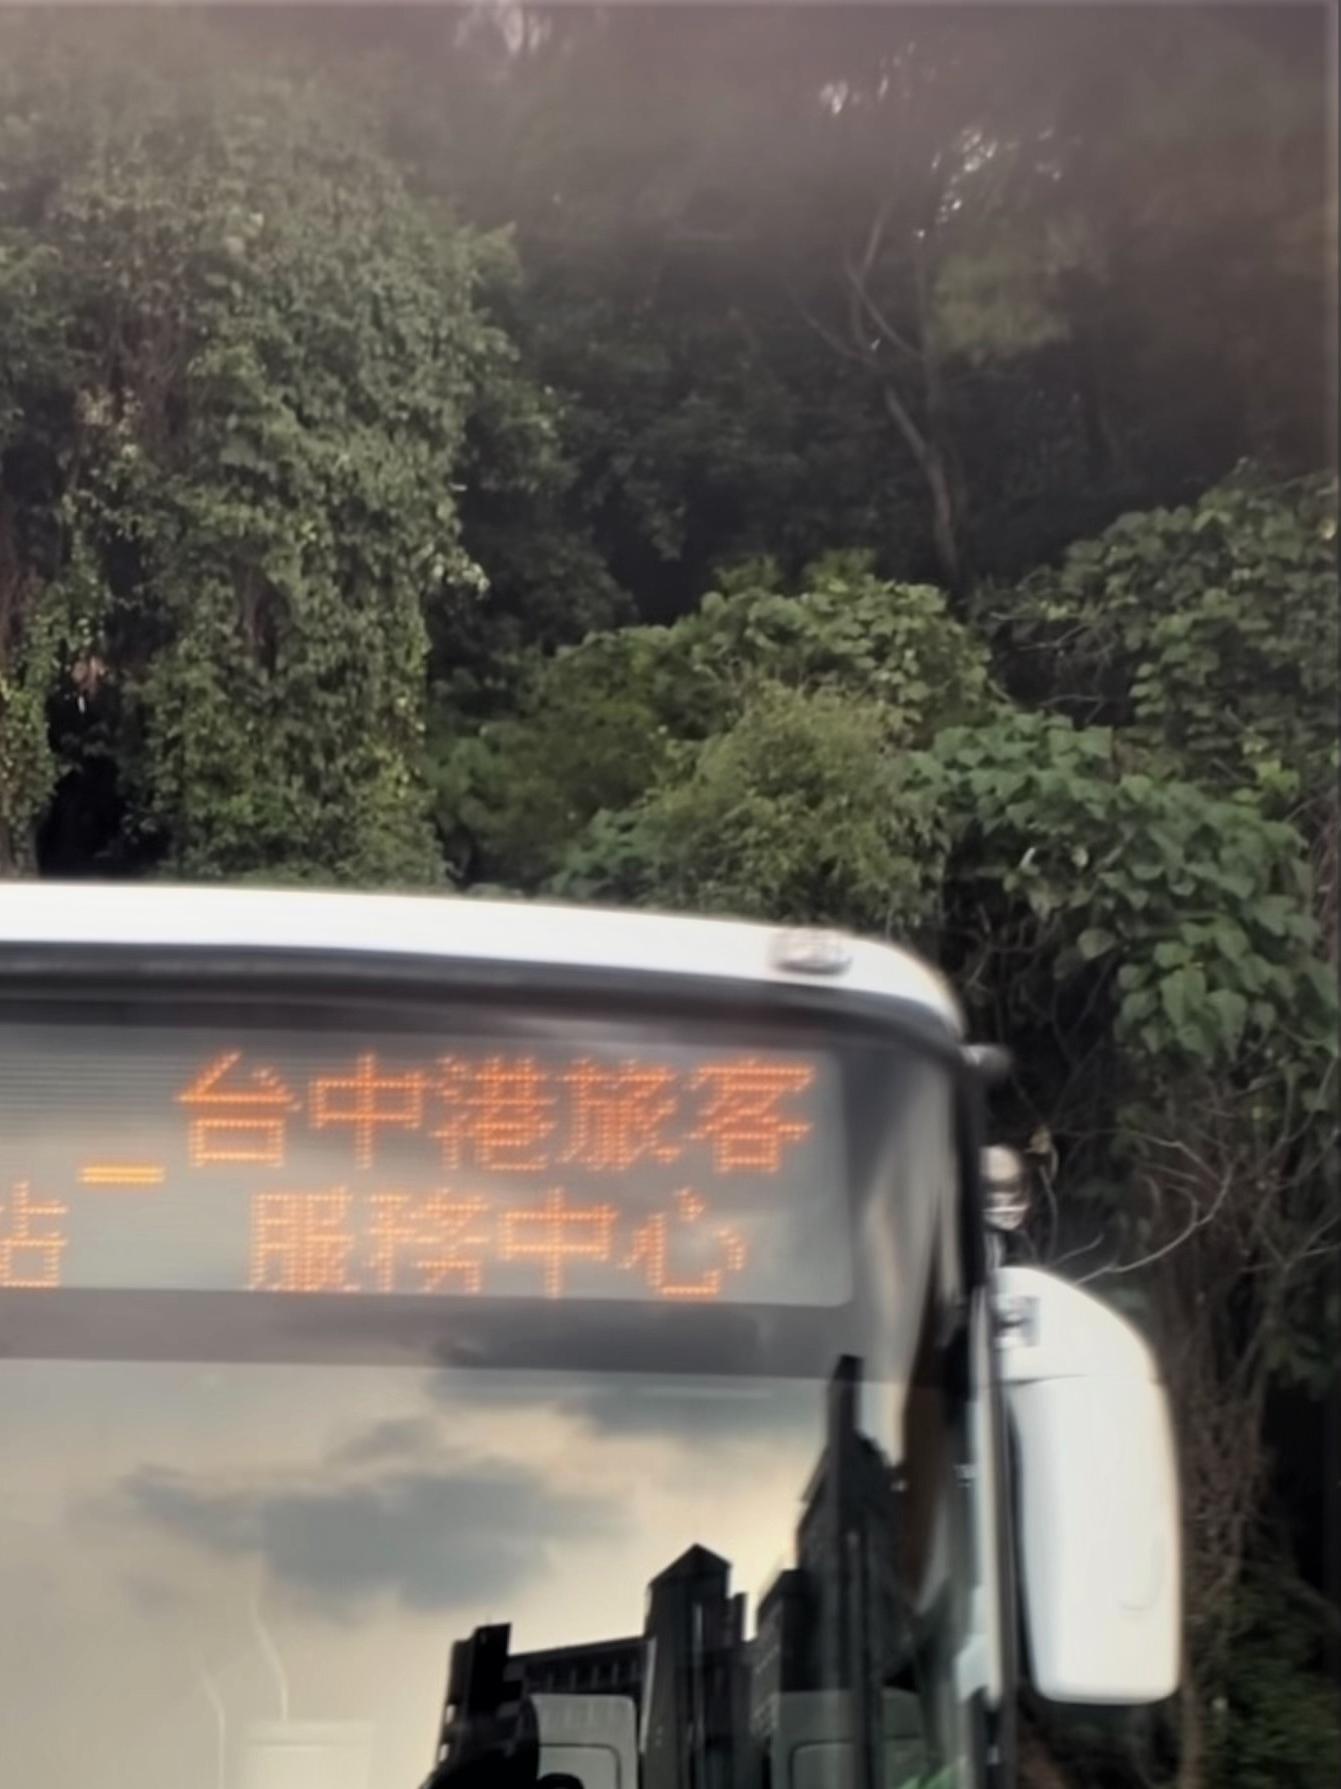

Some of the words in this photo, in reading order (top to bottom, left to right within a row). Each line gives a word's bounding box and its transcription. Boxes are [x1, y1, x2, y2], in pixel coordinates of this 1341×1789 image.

[176, 1048, 818, 1176] 台中港旅客
[246, 1185, 750, 1300] 服務中心
